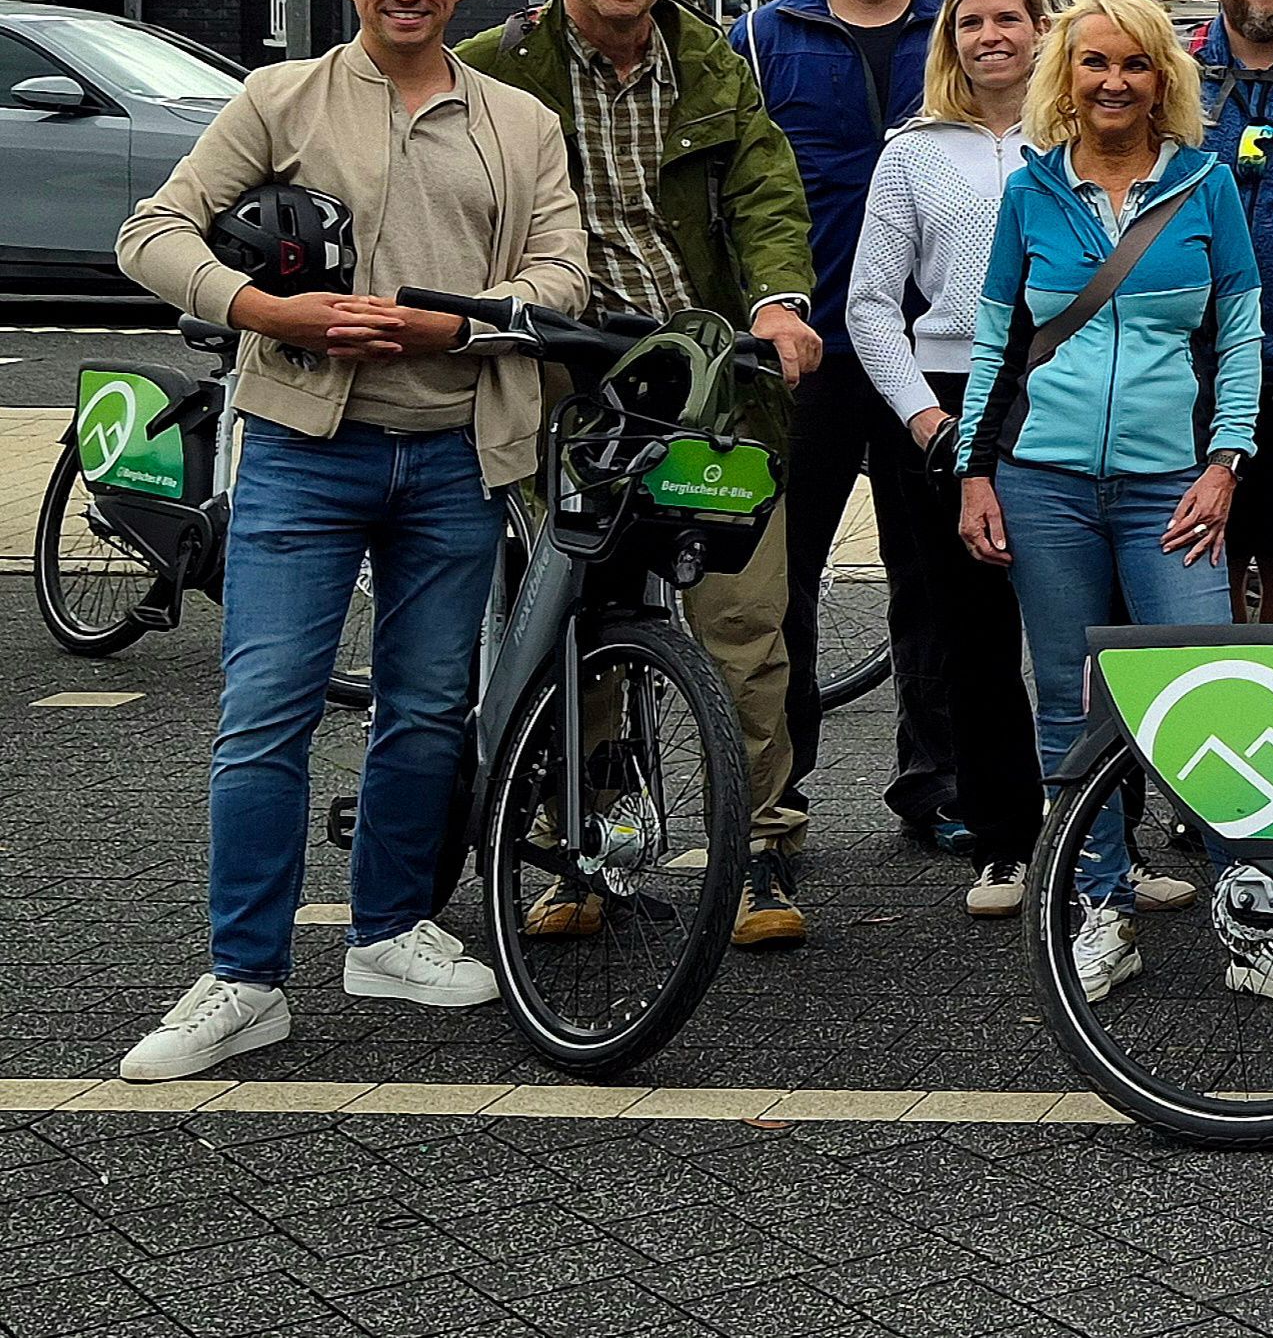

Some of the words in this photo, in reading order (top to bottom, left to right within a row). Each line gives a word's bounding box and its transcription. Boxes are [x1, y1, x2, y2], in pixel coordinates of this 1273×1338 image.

[661, 480, 718, 496] Bergisches
[719, 486, 754, 499] e-Bike
[513, 546, 550, 647] nextbike
